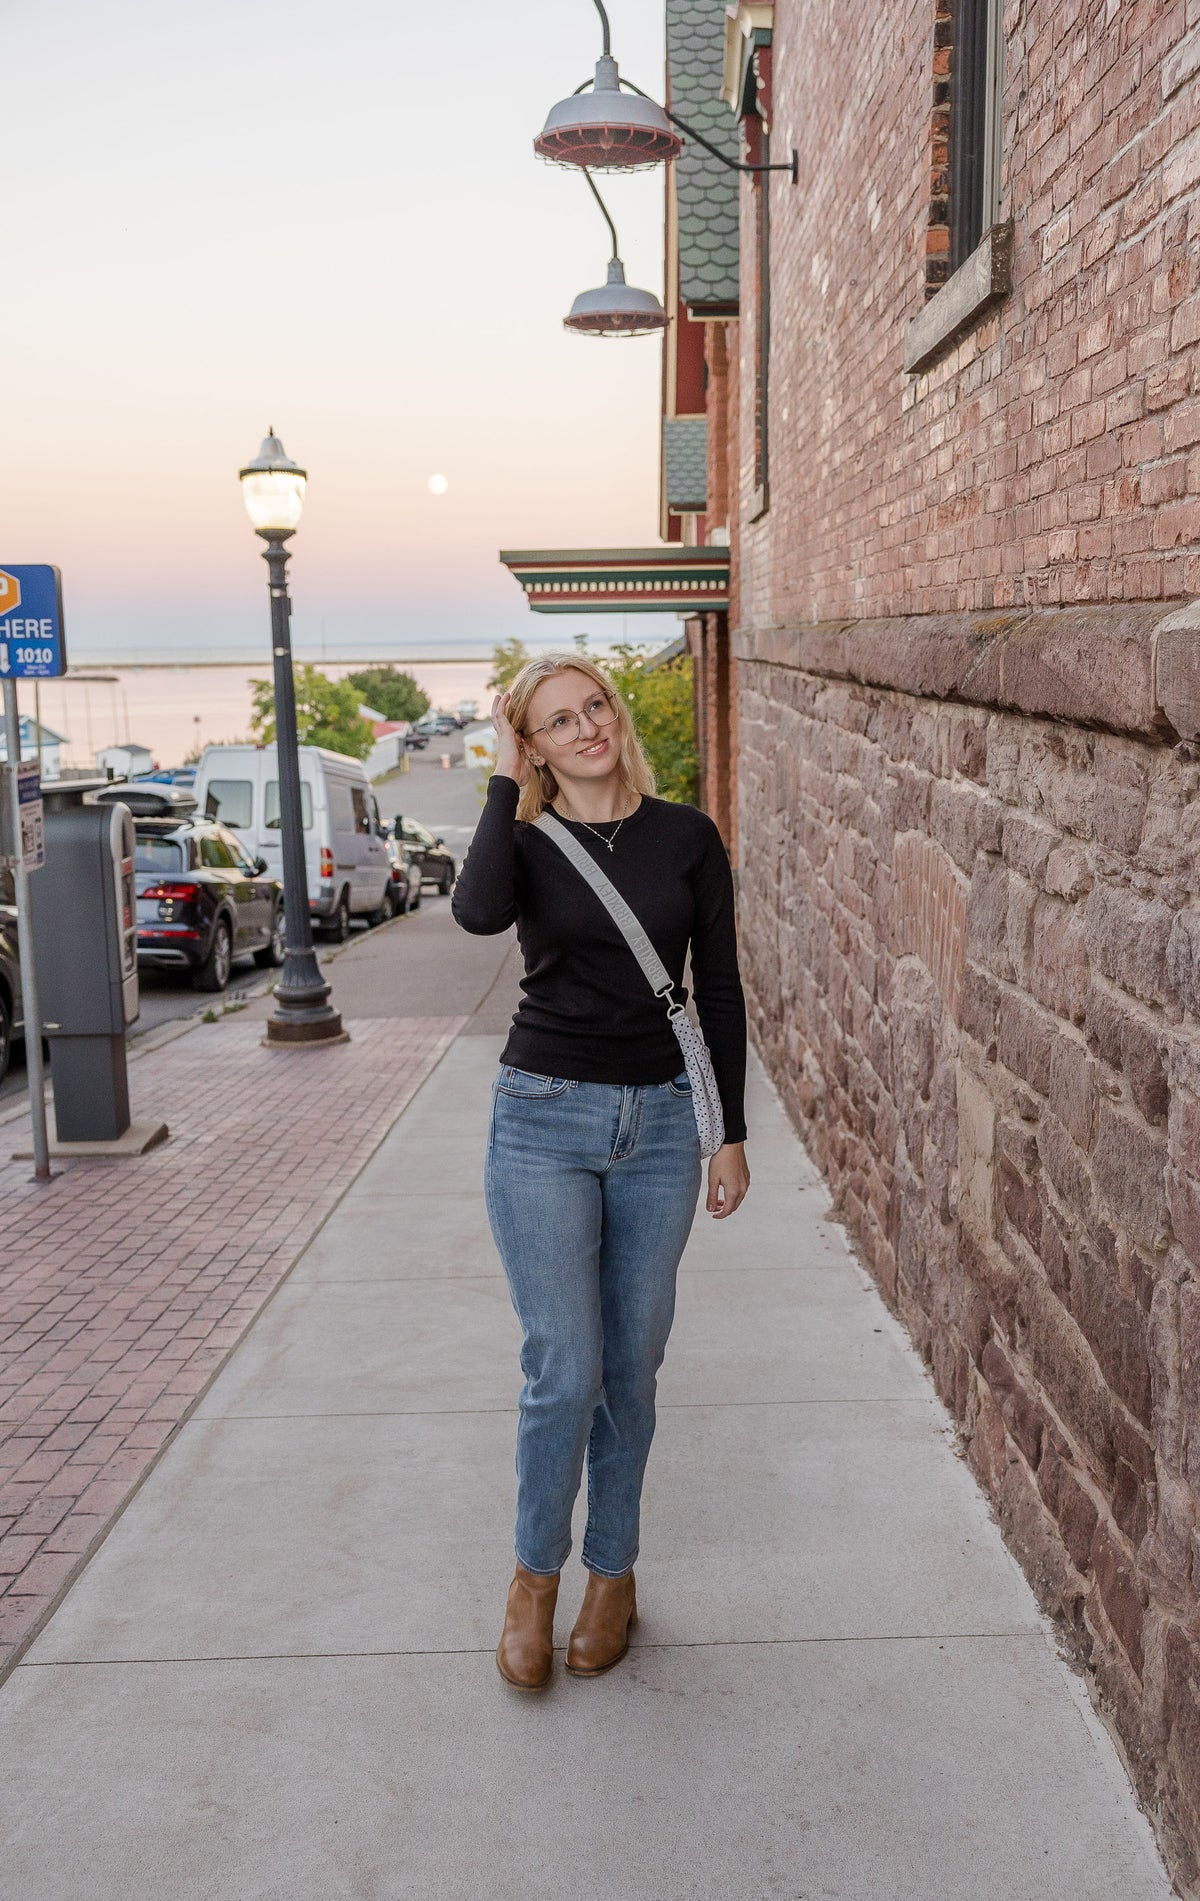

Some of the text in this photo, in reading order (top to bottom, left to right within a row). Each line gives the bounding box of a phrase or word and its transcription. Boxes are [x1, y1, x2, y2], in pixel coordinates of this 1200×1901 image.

[0, 618, 53, 638] HERE
[15, 647, 53, 664] 1010
[595, 883, 634, 928] BRIXLEY
[629, 935, 665, 982] BRIXLEY
